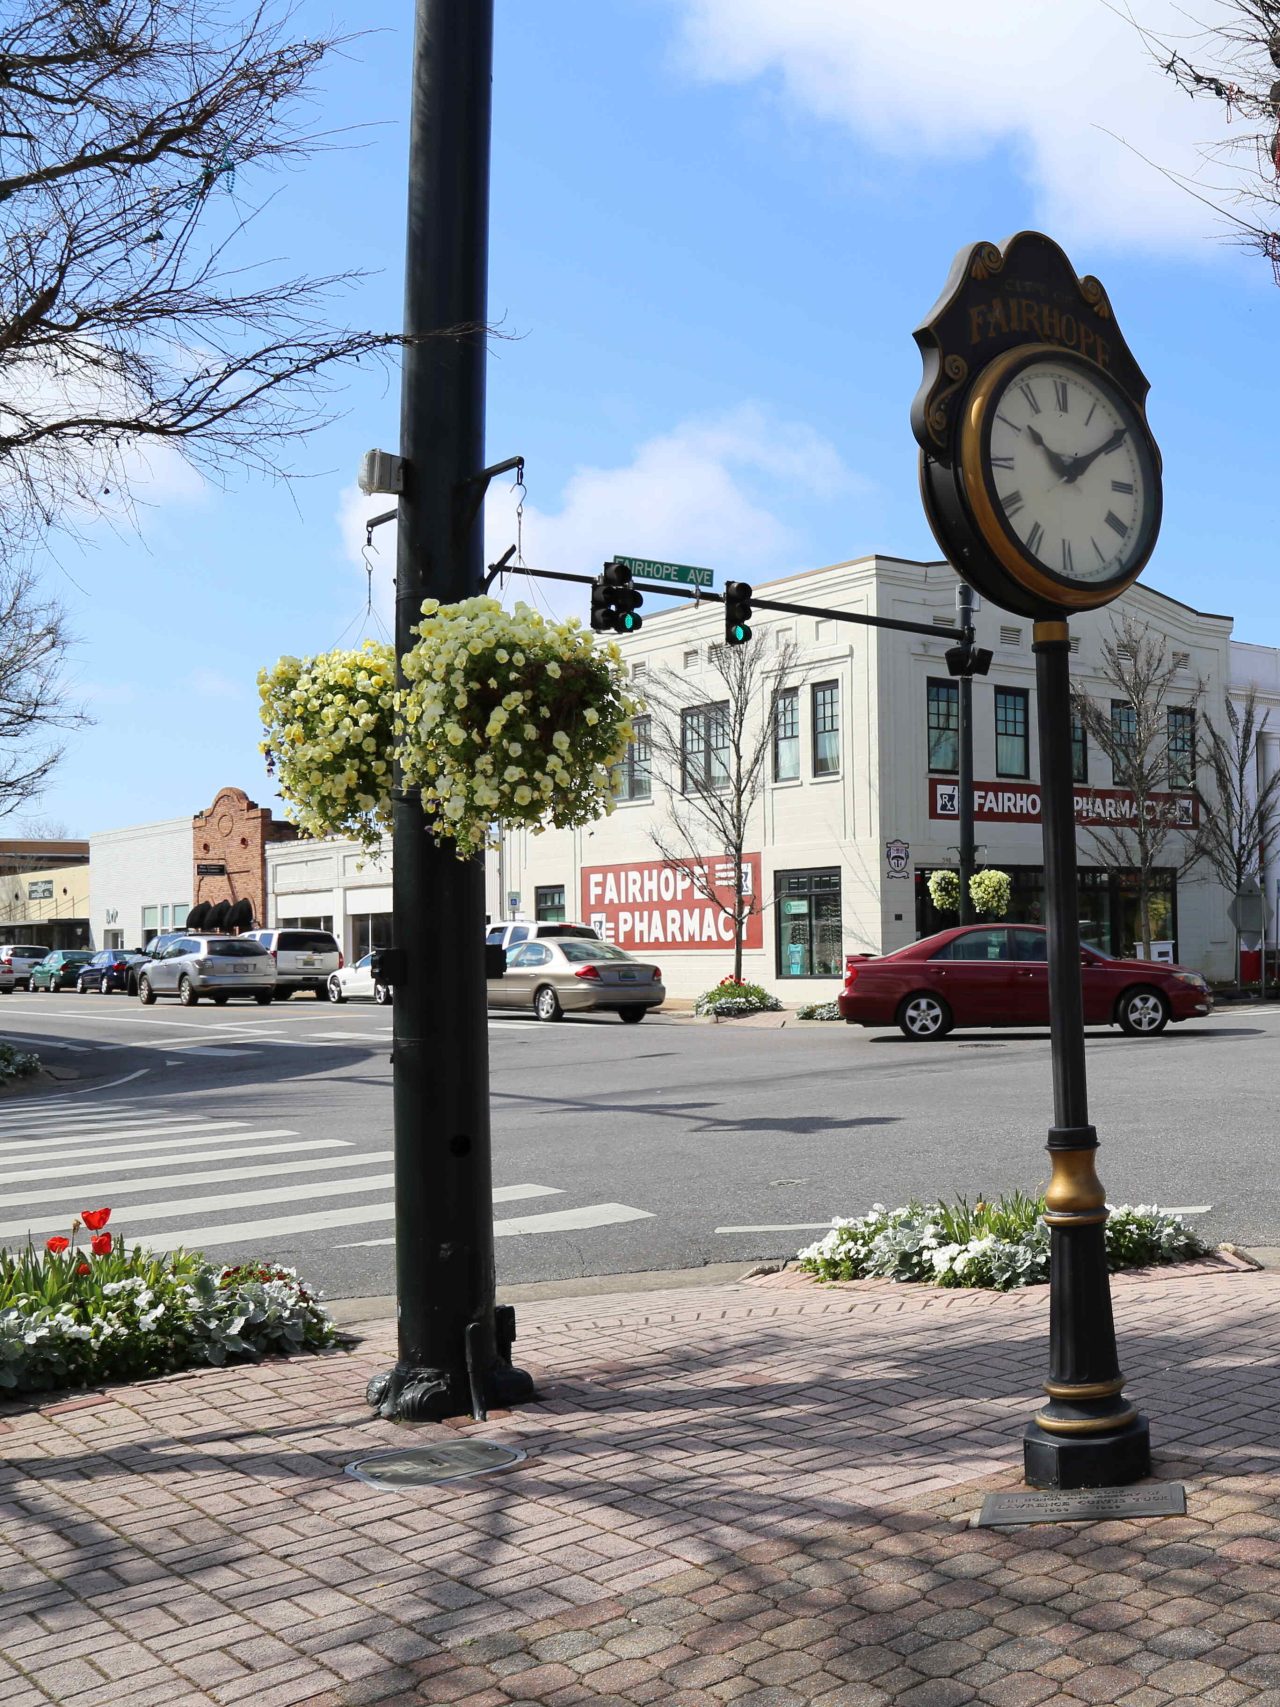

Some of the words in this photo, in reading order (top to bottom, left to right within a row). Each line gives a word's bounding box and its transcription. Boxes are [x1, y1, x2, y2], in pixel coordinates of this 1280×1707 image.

[968, 297, 1111, 366] FAIRHOPE
[687, 568, 712, 585] AVE
[973, 790, 1041, 815] FAIRHO
[1073, 796, 1164, 820] PHARMACY
[589, 864, 710, 905] FAIRHOPE
[618, 905, 751, 943] PHARMACY
